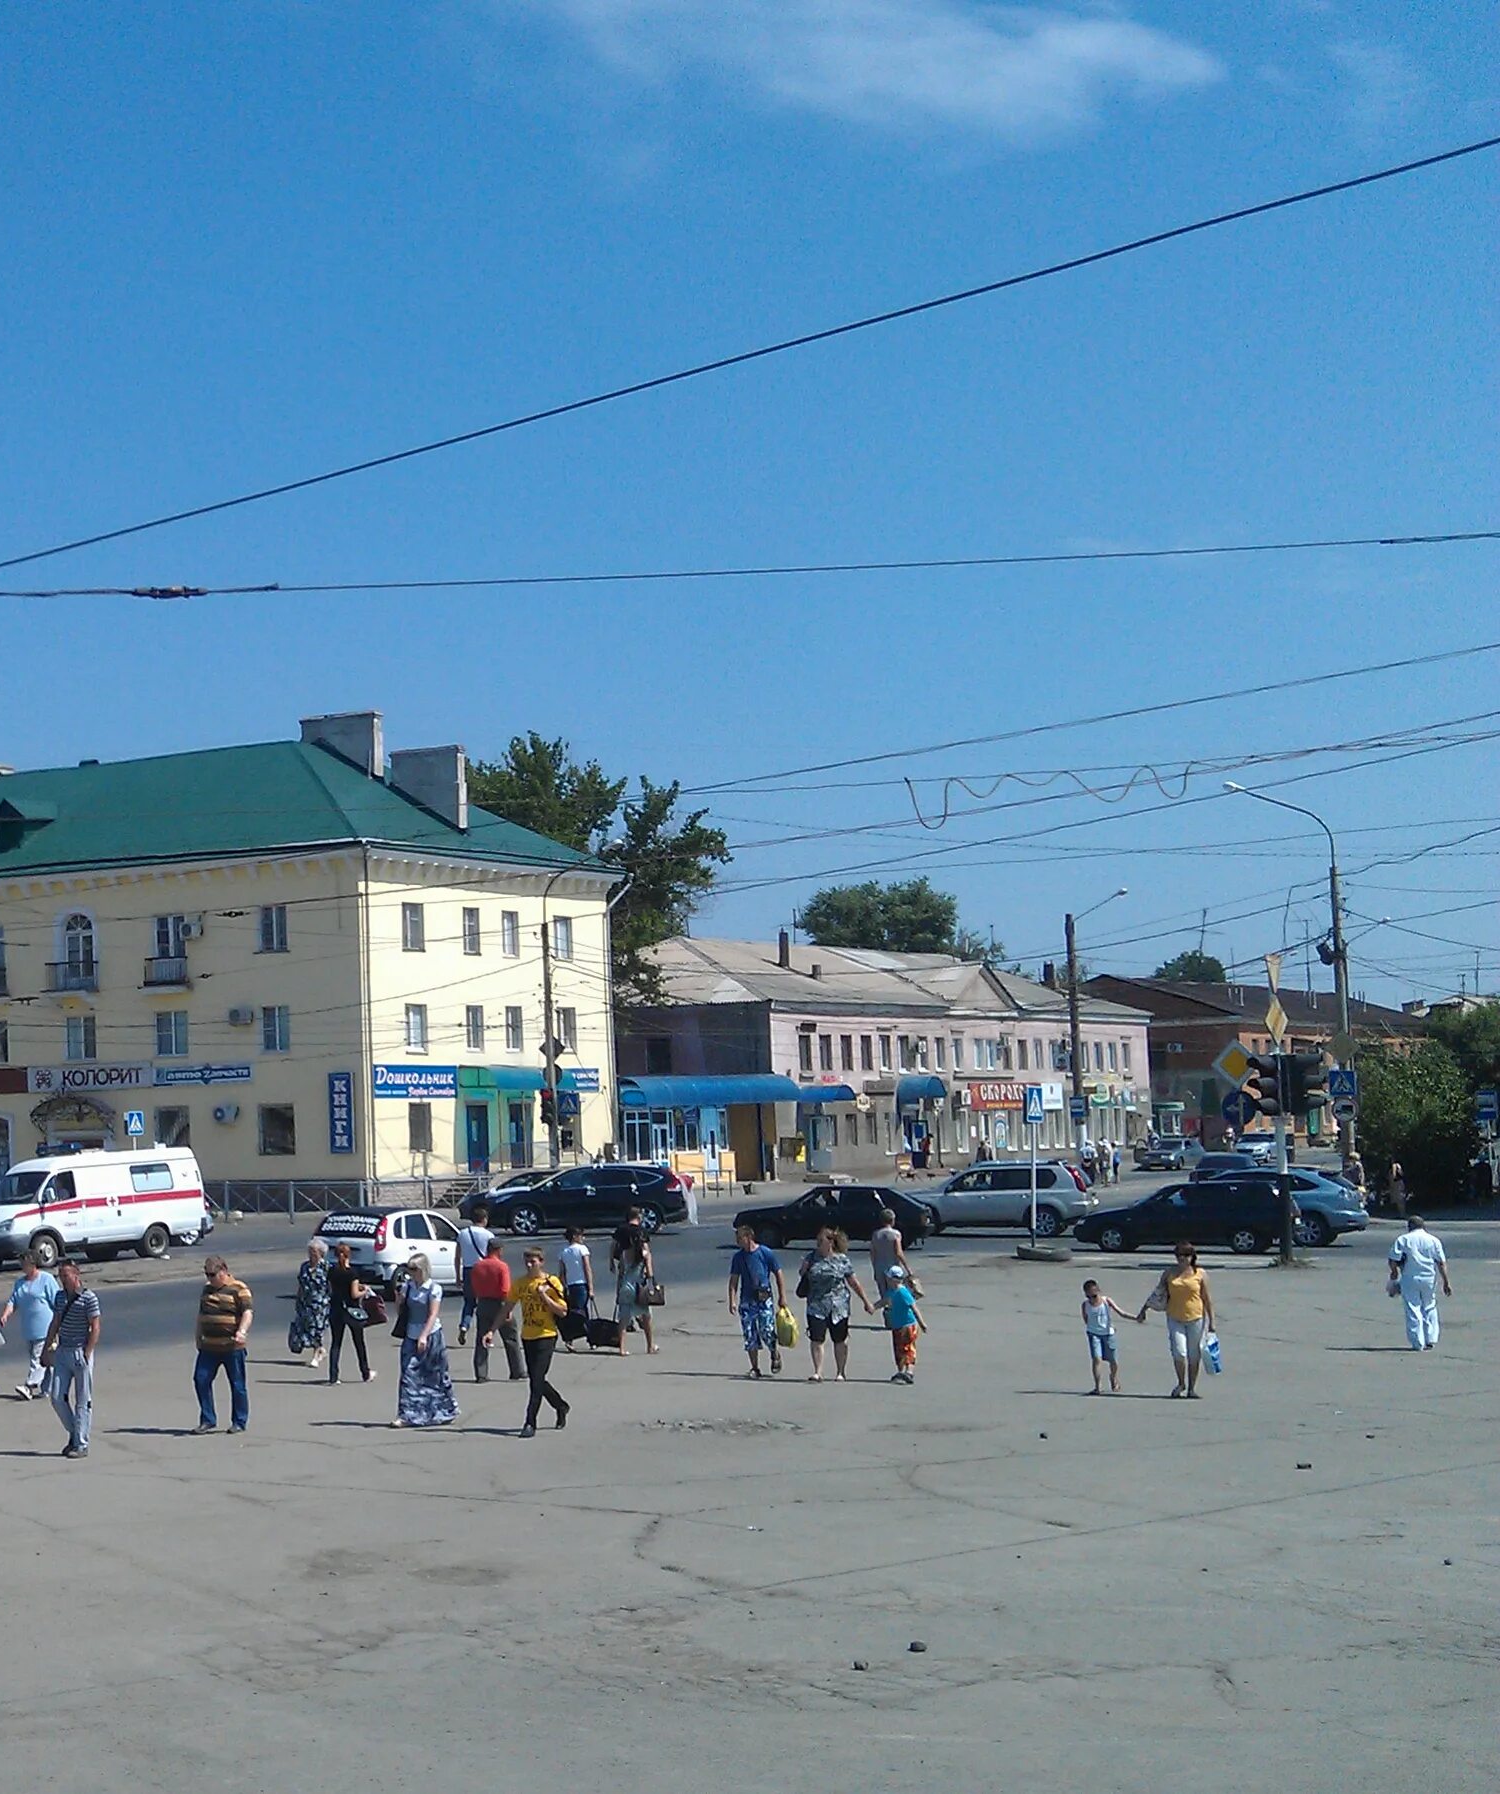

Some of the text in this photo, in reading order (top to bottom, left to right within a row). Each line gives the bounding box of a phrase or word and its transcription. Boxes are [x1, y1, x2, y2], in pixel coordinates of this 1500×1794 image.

[62, 1068, 143, 1087] КОЛОРИТ
[980, 1084, 1023, 1100] СКОРОХО
[333, 1080, 348, 1147] КНИГИ
